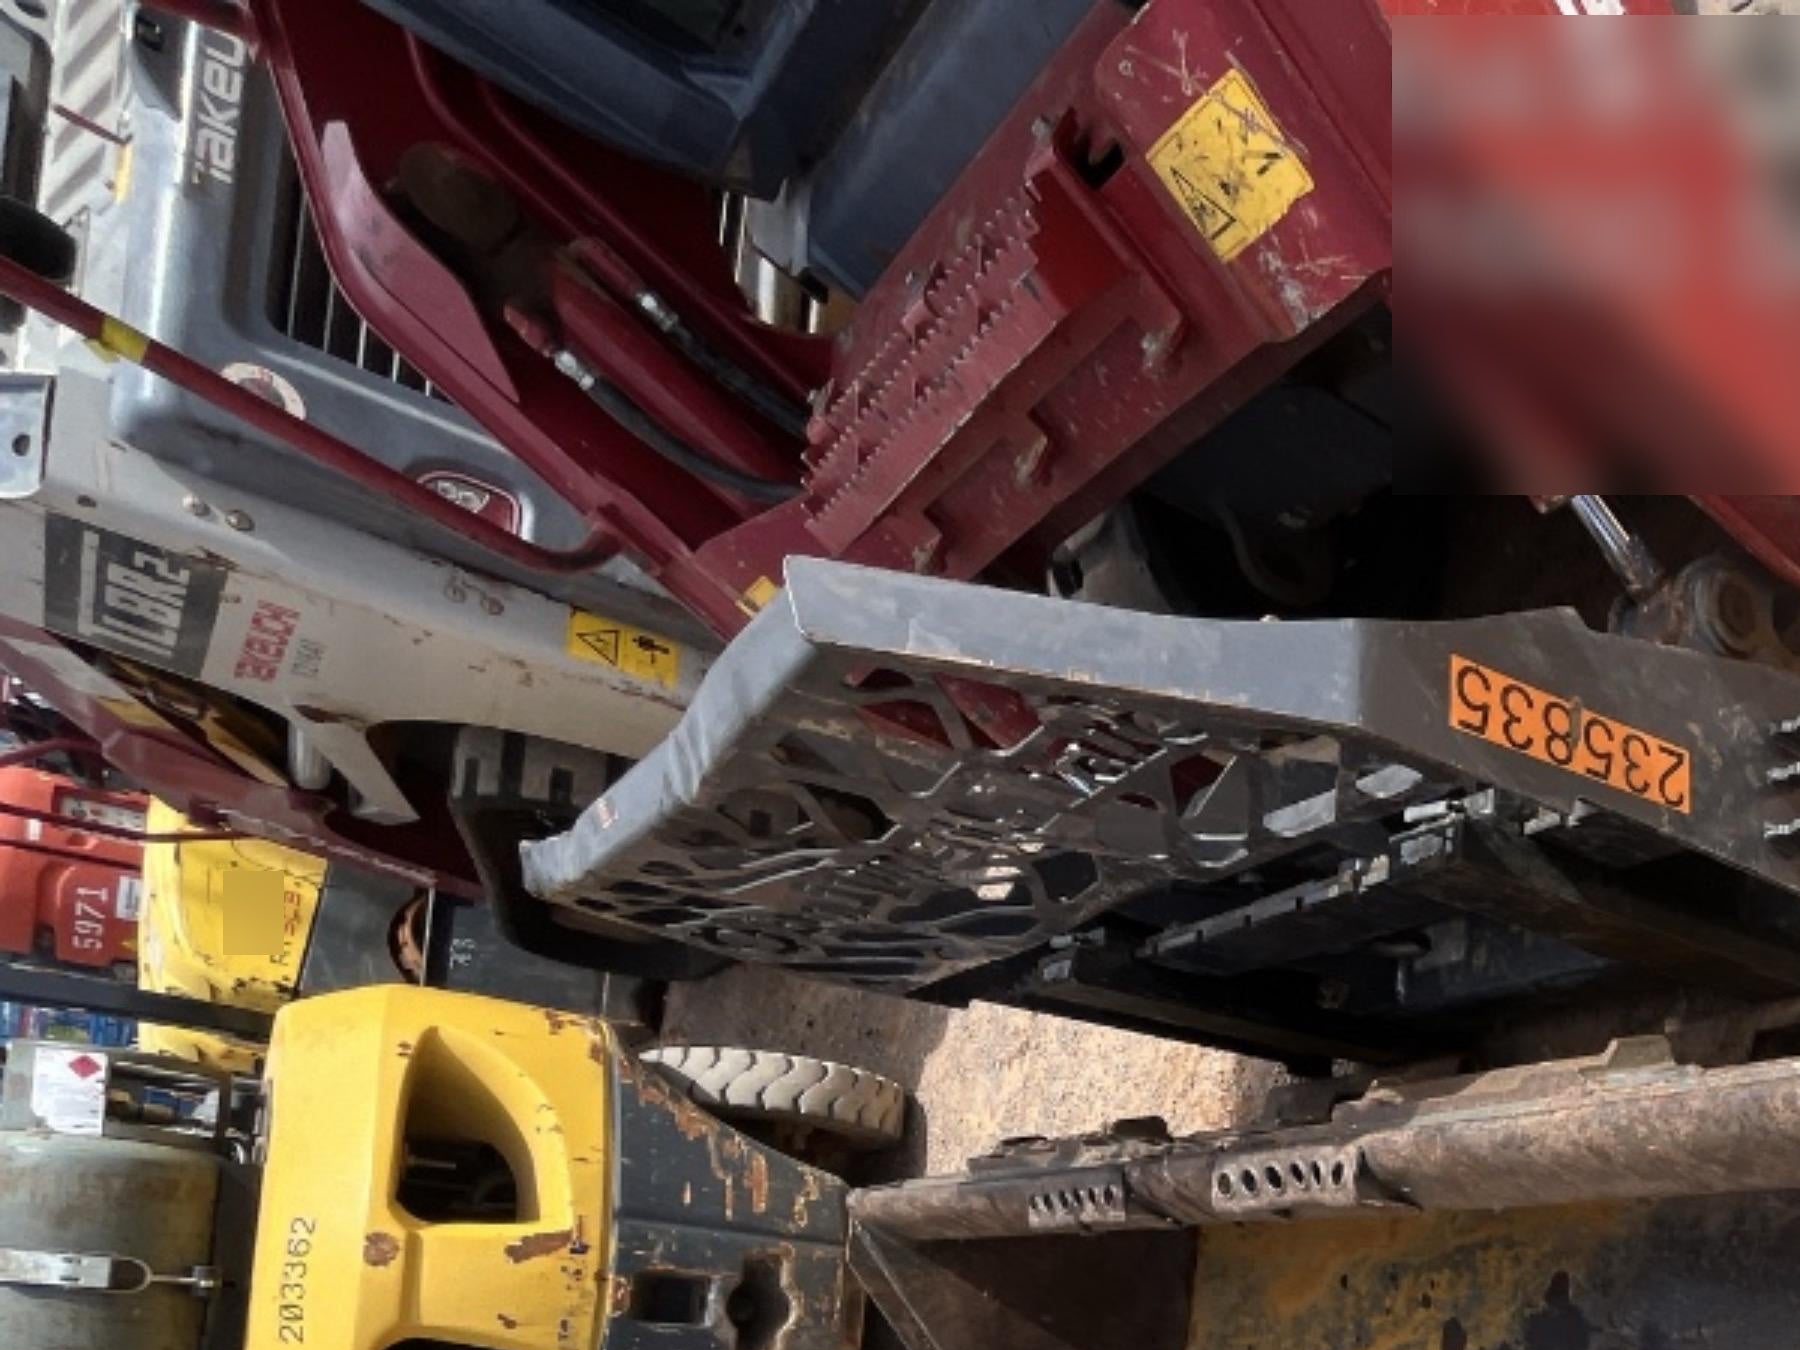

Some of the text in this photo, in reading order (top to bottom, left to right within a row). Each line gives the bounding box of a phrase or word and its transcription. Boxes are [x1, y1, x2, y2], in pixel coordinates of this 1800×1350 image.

[1454, 664, 1687, 809] 235835
[72, 885, 109, 950] 5971
[277, 1215, 316, 1345] 203362
